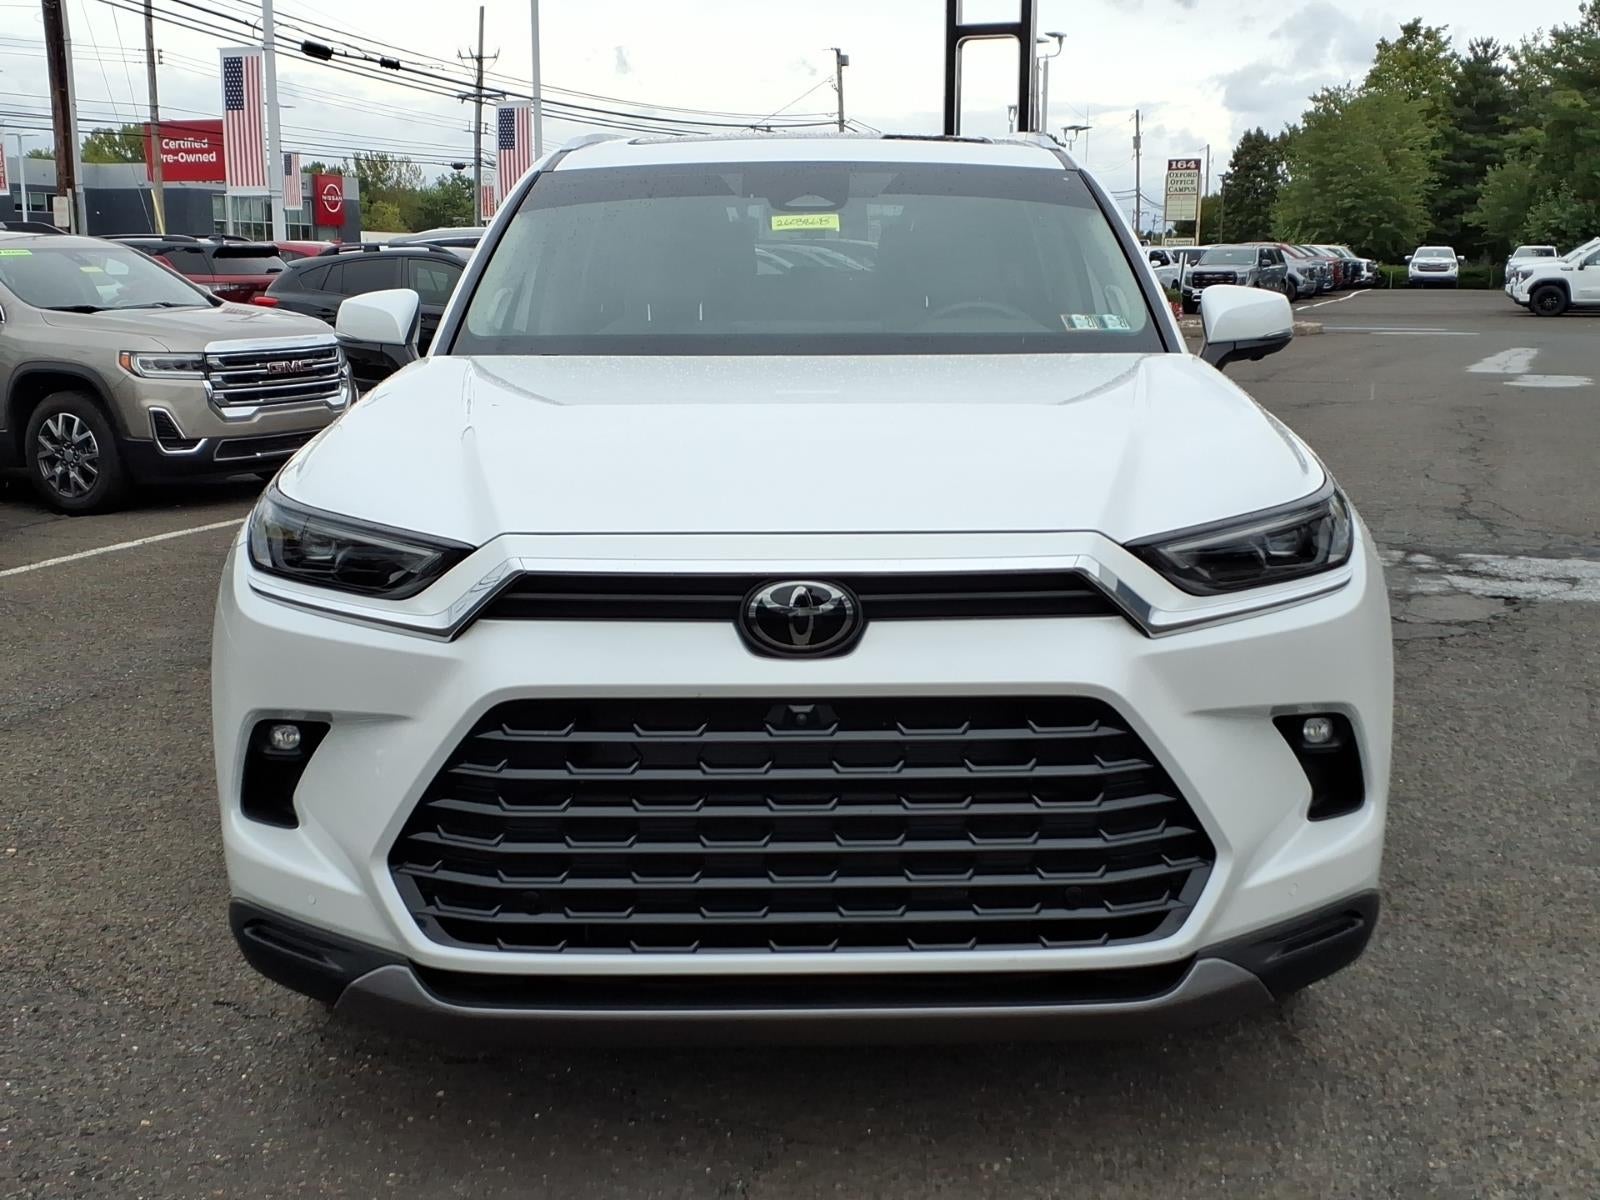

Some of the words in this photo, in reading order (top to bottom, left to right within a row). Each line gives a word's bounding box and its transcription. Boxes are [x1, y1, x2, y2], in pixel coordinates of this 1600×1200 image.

[162, 137, 208, 149] Certified
[160, 151, 217, 163] re-Owned
[1170, 160, 1196, 169] 164
[321, 194, 343, 202] NISSAN
[266, 359, 314, 374] GMC
